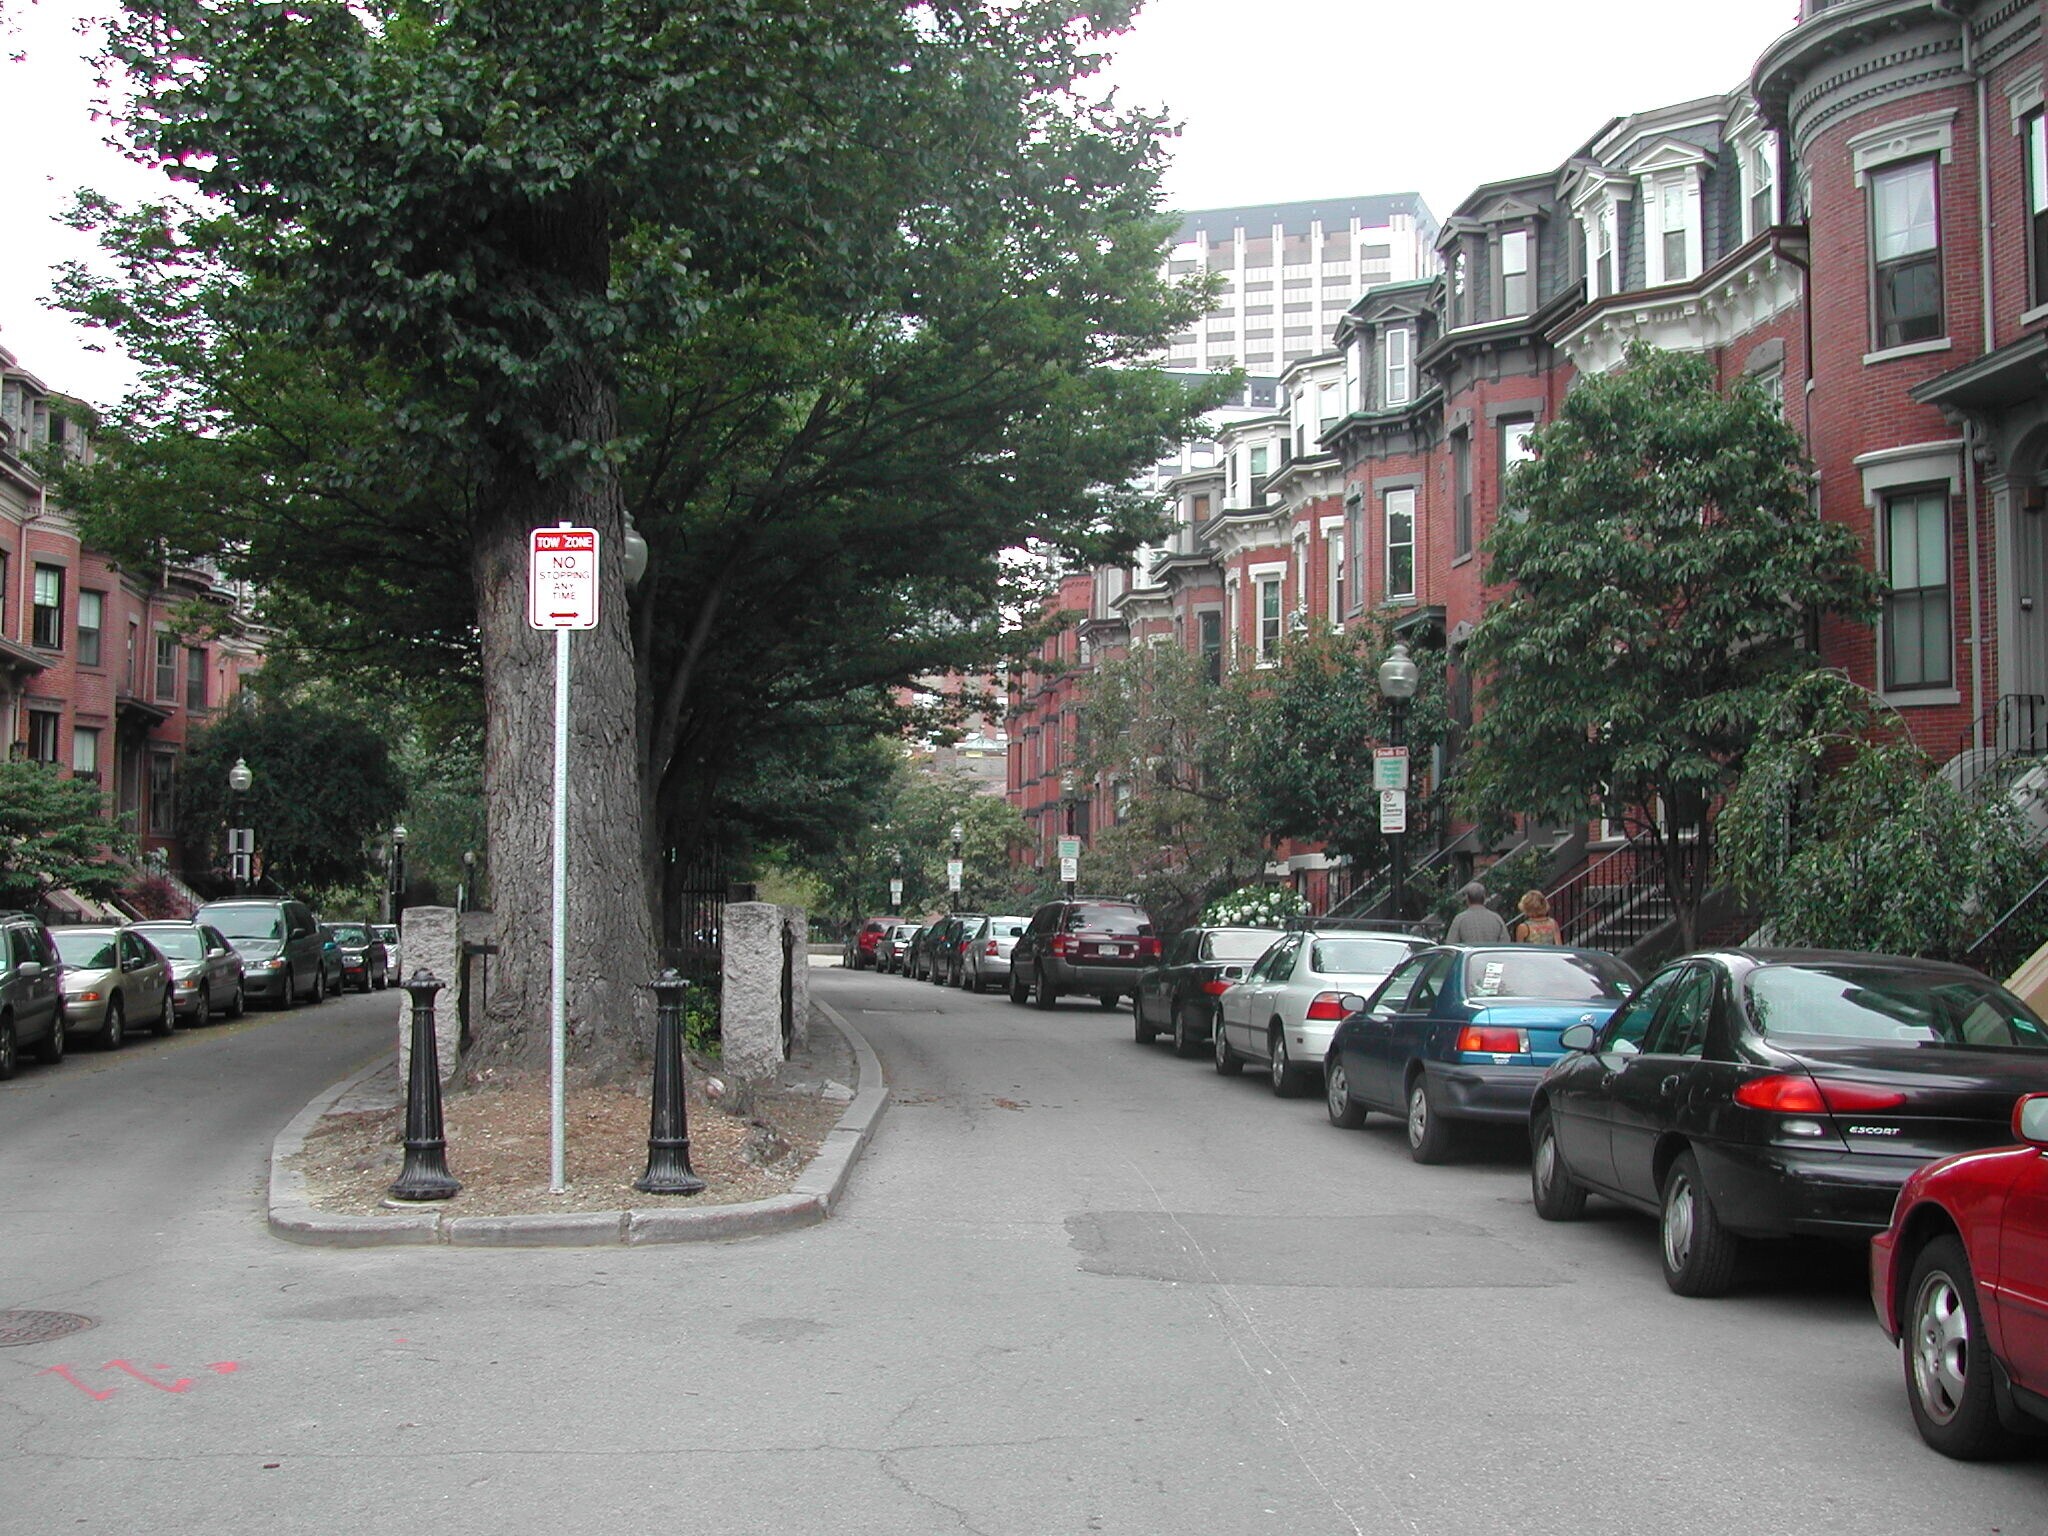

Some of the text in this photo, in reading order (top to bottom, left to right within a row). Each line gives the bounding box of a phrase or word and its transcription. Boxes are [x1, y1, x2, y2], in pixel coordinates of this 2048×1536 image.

[537, 536, 593, 548] TOW ZONE
[553, 556, 576, 569] NO
[539, 571, 590, 580] STOPPING
[553, 592, 576, 600] TIME
[1849, 1126, 1900, 1135] ESCORT
